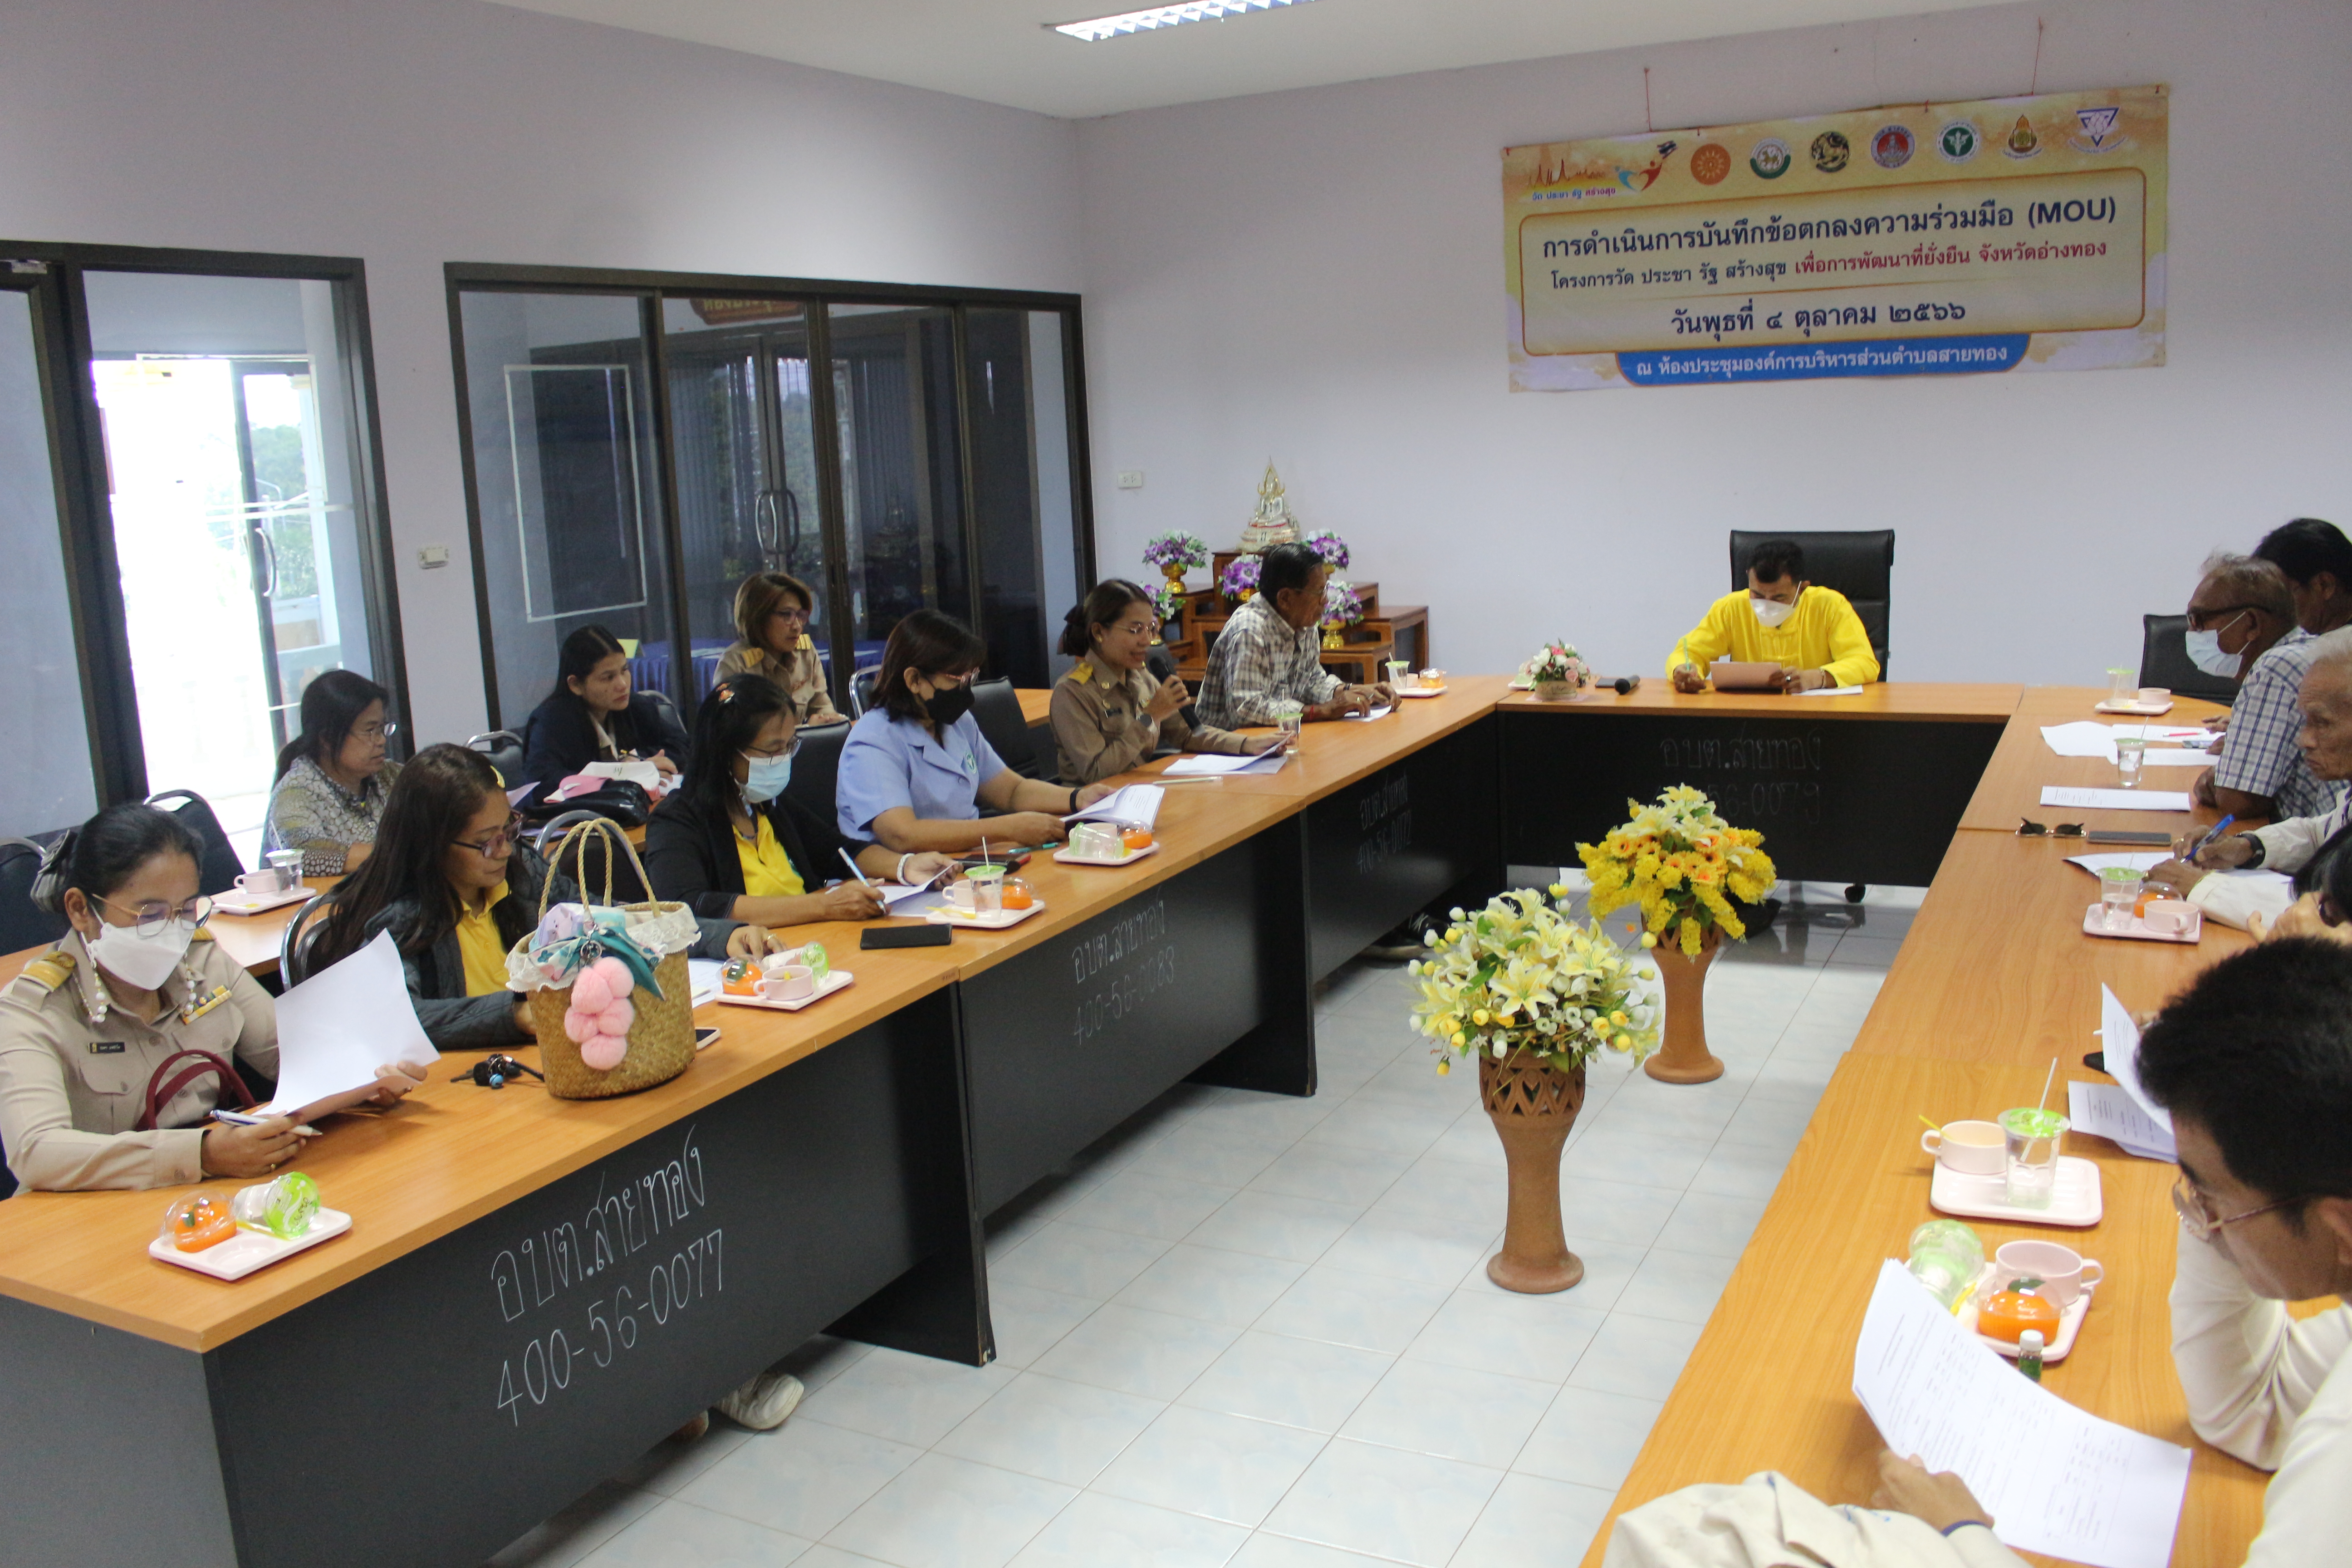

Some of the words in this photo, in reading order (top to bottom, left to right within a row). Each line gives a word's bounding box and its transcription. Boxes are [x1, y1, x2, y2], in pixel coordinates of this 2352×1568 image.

[1543, 199, 2014, 258] การดำเนินการบันทึกข้อตกลงความร่วมมือ
[2028, 196, 2117, 229] (MOU)
[1551, 268, 1634, 290] โครงการวัด
[1642, 269, 1692, 284] ประชา
[1699, 262, 1718, 285] รัฐ
[1725, 259, 1787, 283] สร้างสุข
[1794, 241, 1970, 274] เพื่อการพัฒนาที่ยั่งยืน
[1979, 240, 2107, 262] จังหวัดอ่างทอง
[1671, 298, 1754, 342] วันพุธที่
[1766, 314, 1784, 330] ๔
[1794, 305, 1877, 338] ตุลาคม
[1889, 301, 1966, 323] ๒๕๖๖
[1636, 359, 1653, 377] ณ
[1658, 345, 2008, 380] ห้องประชุมองค์การบริหารส่วนตำบลสายทอง
[491, 1123, 705, 1322] อบต.สายทอง
[498, 1228, 722, 1427] 400-56-0077
